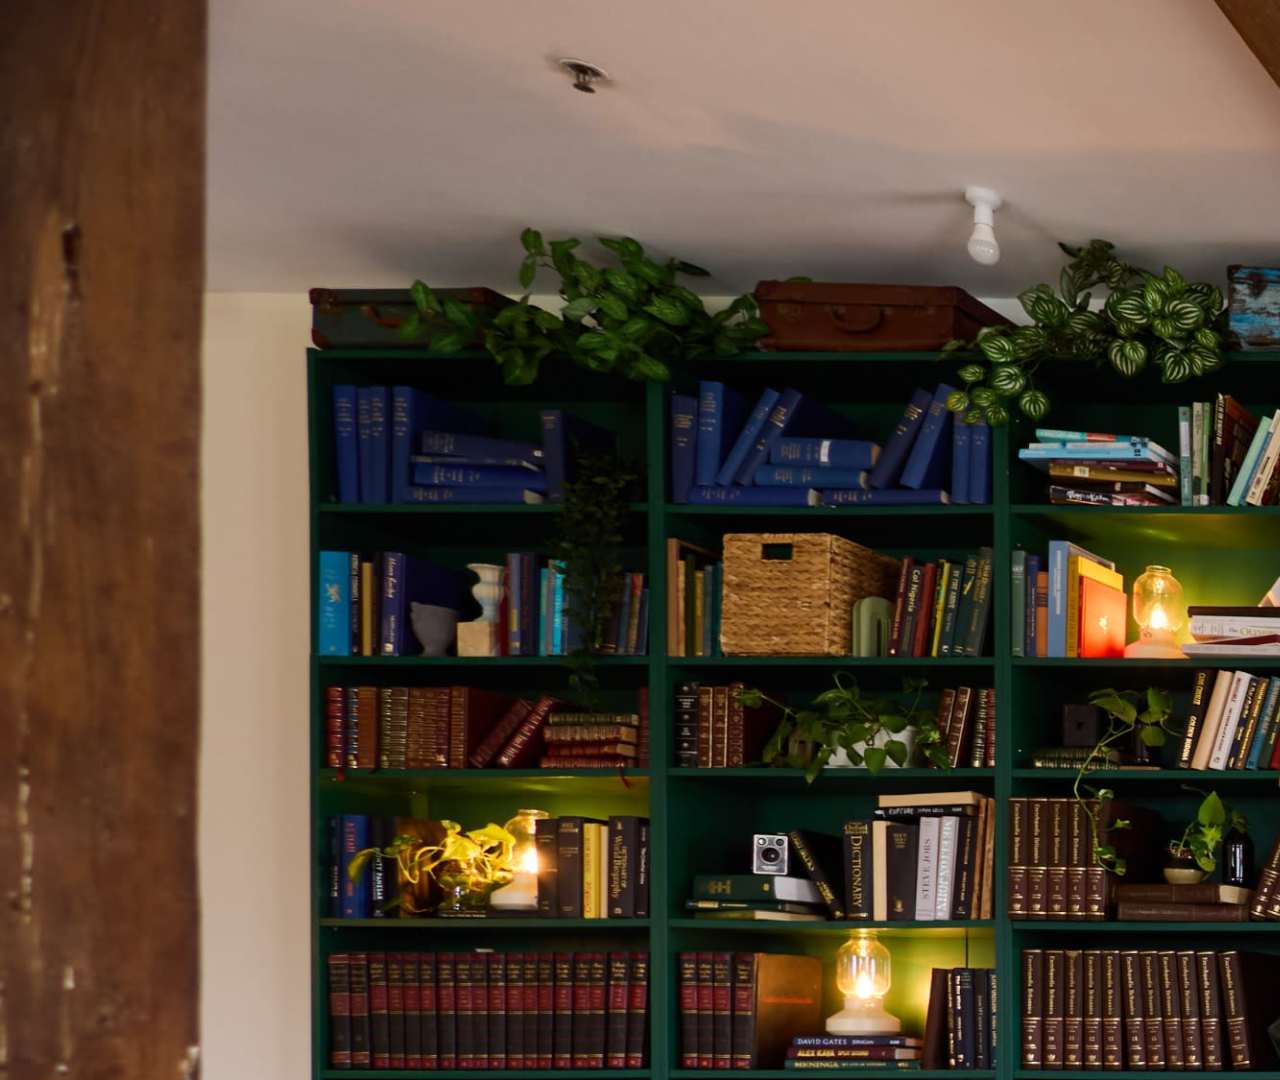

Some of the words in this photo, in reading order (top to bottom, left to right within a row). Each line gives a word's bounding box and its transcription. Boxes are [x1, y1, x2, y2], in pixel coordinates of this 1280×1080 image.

[851, 836, 863, 907] DICTIONARY
[797, 1038, 822, 1046] DAVID
[823, 1038, 848, 1046] GATES
